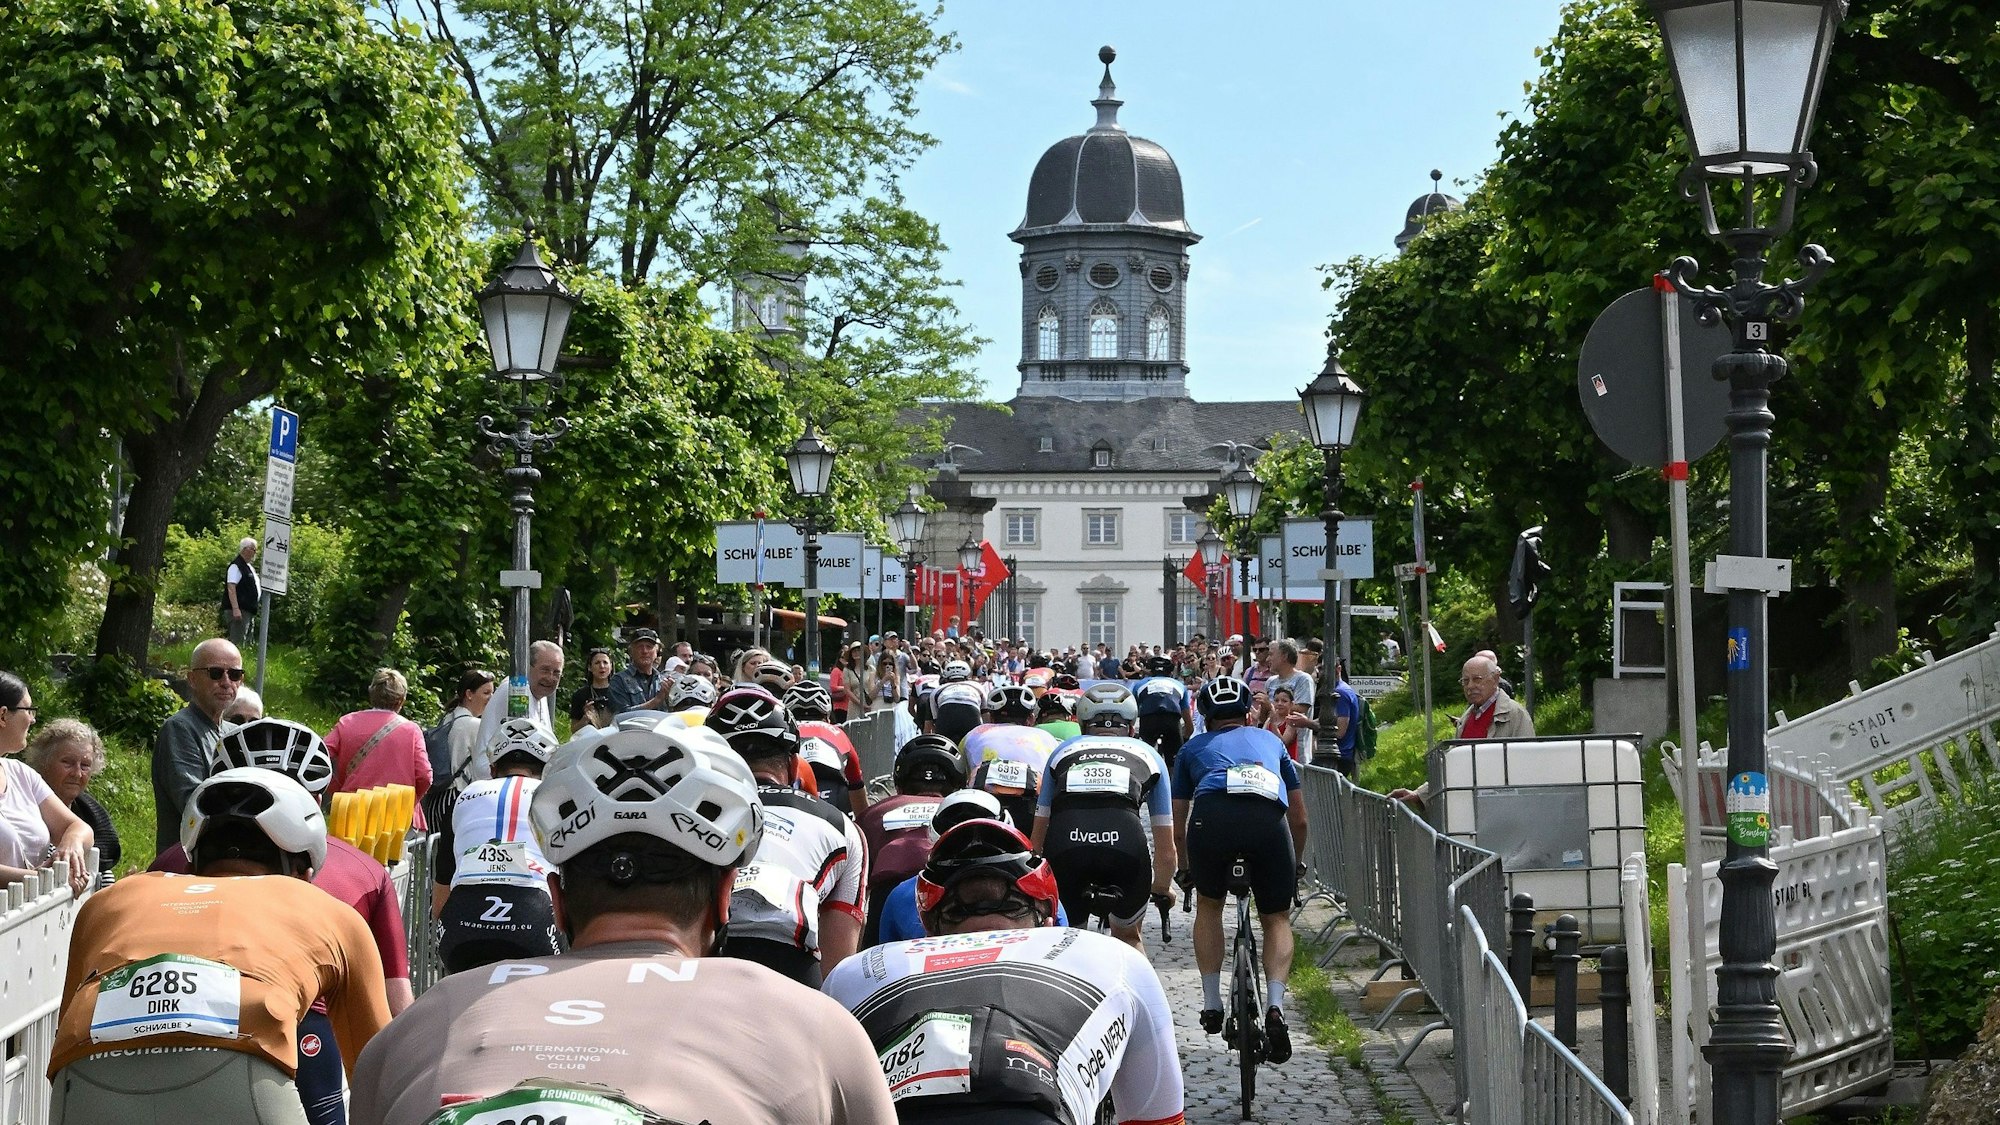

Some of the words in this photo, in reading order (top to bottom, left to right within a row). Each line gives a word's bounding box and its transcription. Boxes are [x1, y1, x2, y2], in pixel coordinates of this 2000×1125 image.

[1752, 324, 1760, 338] 3
[279, 415, 290, 446] P
[1848, 707, 1896, 737] STADT
[1869, 732, 1890, 749] GL
[1083, 767, 1112, 778] 3358
[614, 811, 647, 820] GARA
[903, 806, 935, 814] 6212
[486, 864, 507, 873] JENS
[1775, 883, 1800, 906] STADT
[460, 920, 532, 932] swan-racing.eu
[488, 963, 549, 985] P
[626, 960, 699, 984] N
[129, 970, 198, 998] 6285
[147, 998, 180, 1014] DIRK
[544, 1000, 606, 1026] S
[133, 1021, 182, 1034] SCHWALBE
[511, 1044, 629, 1056] INTERNATIONAL
[535, 1053, 601, 1062] CYCLING
[880, 1032, 925, 1075] 082
[548, 1062, 586, 1070] CLUB
[886, 1061, 920, 1087] RGEJ
[1077, 1048, 1106, 1089] Cycle
